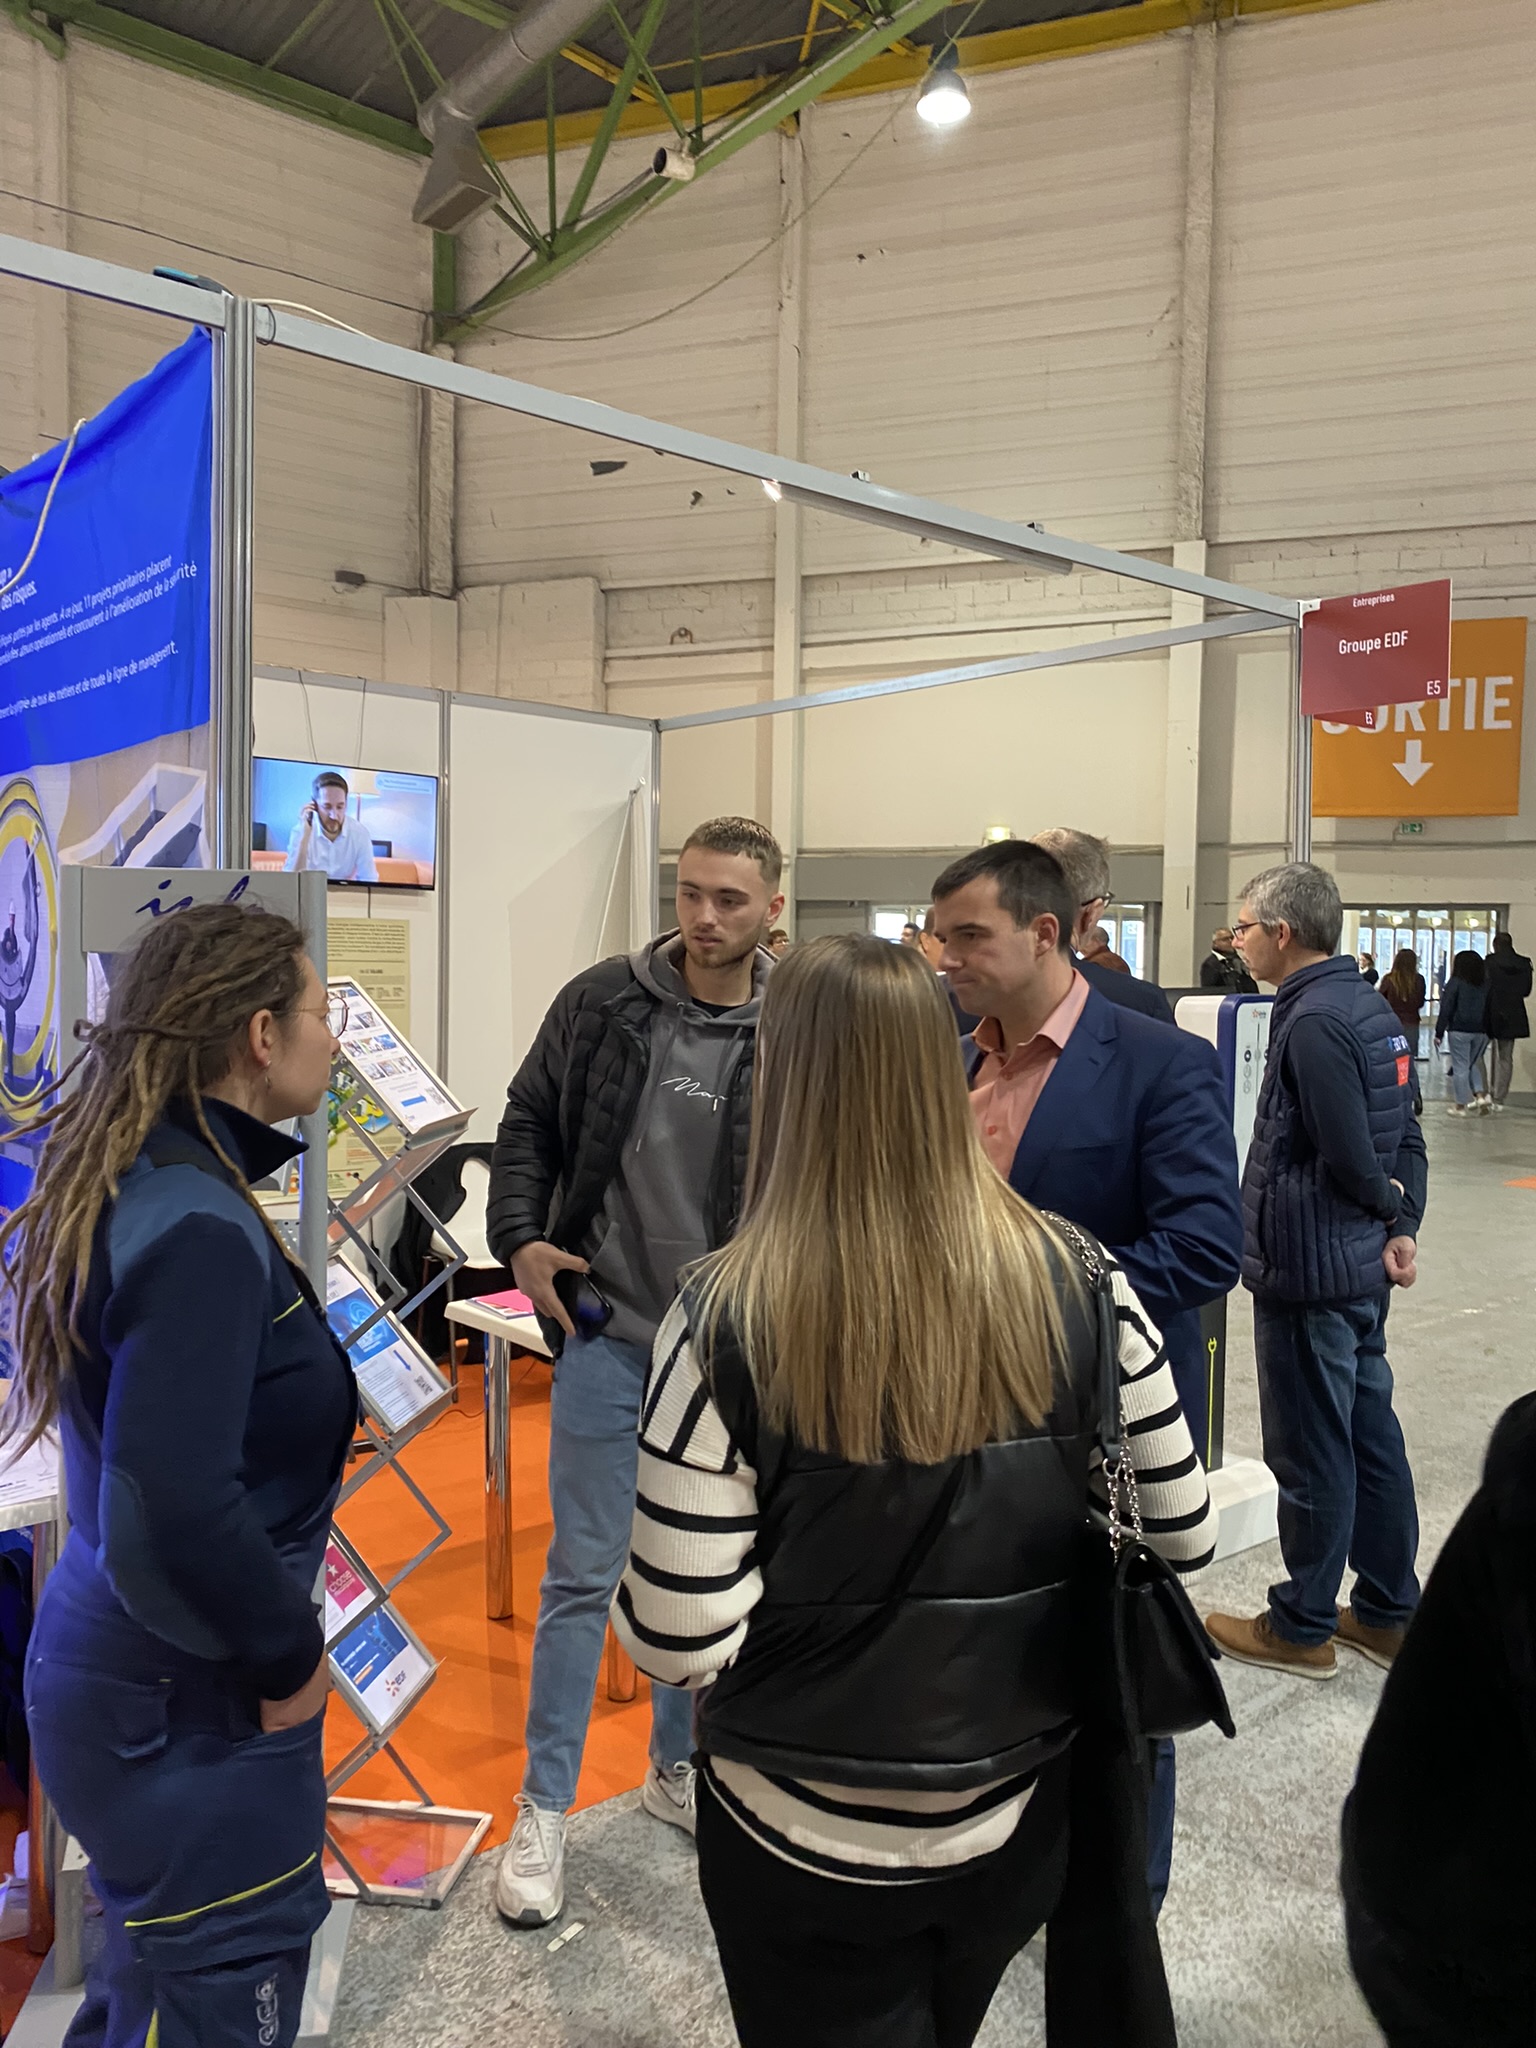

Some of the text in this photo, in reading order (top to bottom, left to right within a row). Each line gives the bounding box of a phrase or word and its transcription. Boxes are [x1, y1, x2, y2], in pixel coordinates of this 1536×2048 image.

[146, 553, 172, 583] placent
[1353, 593, 1395, 608] Entreprises
[1338, 630, 1409, 655] Groupe EDF
[1426, 679, 1441, 696] E5
[1321, 676, 1513, 735] RTIE
